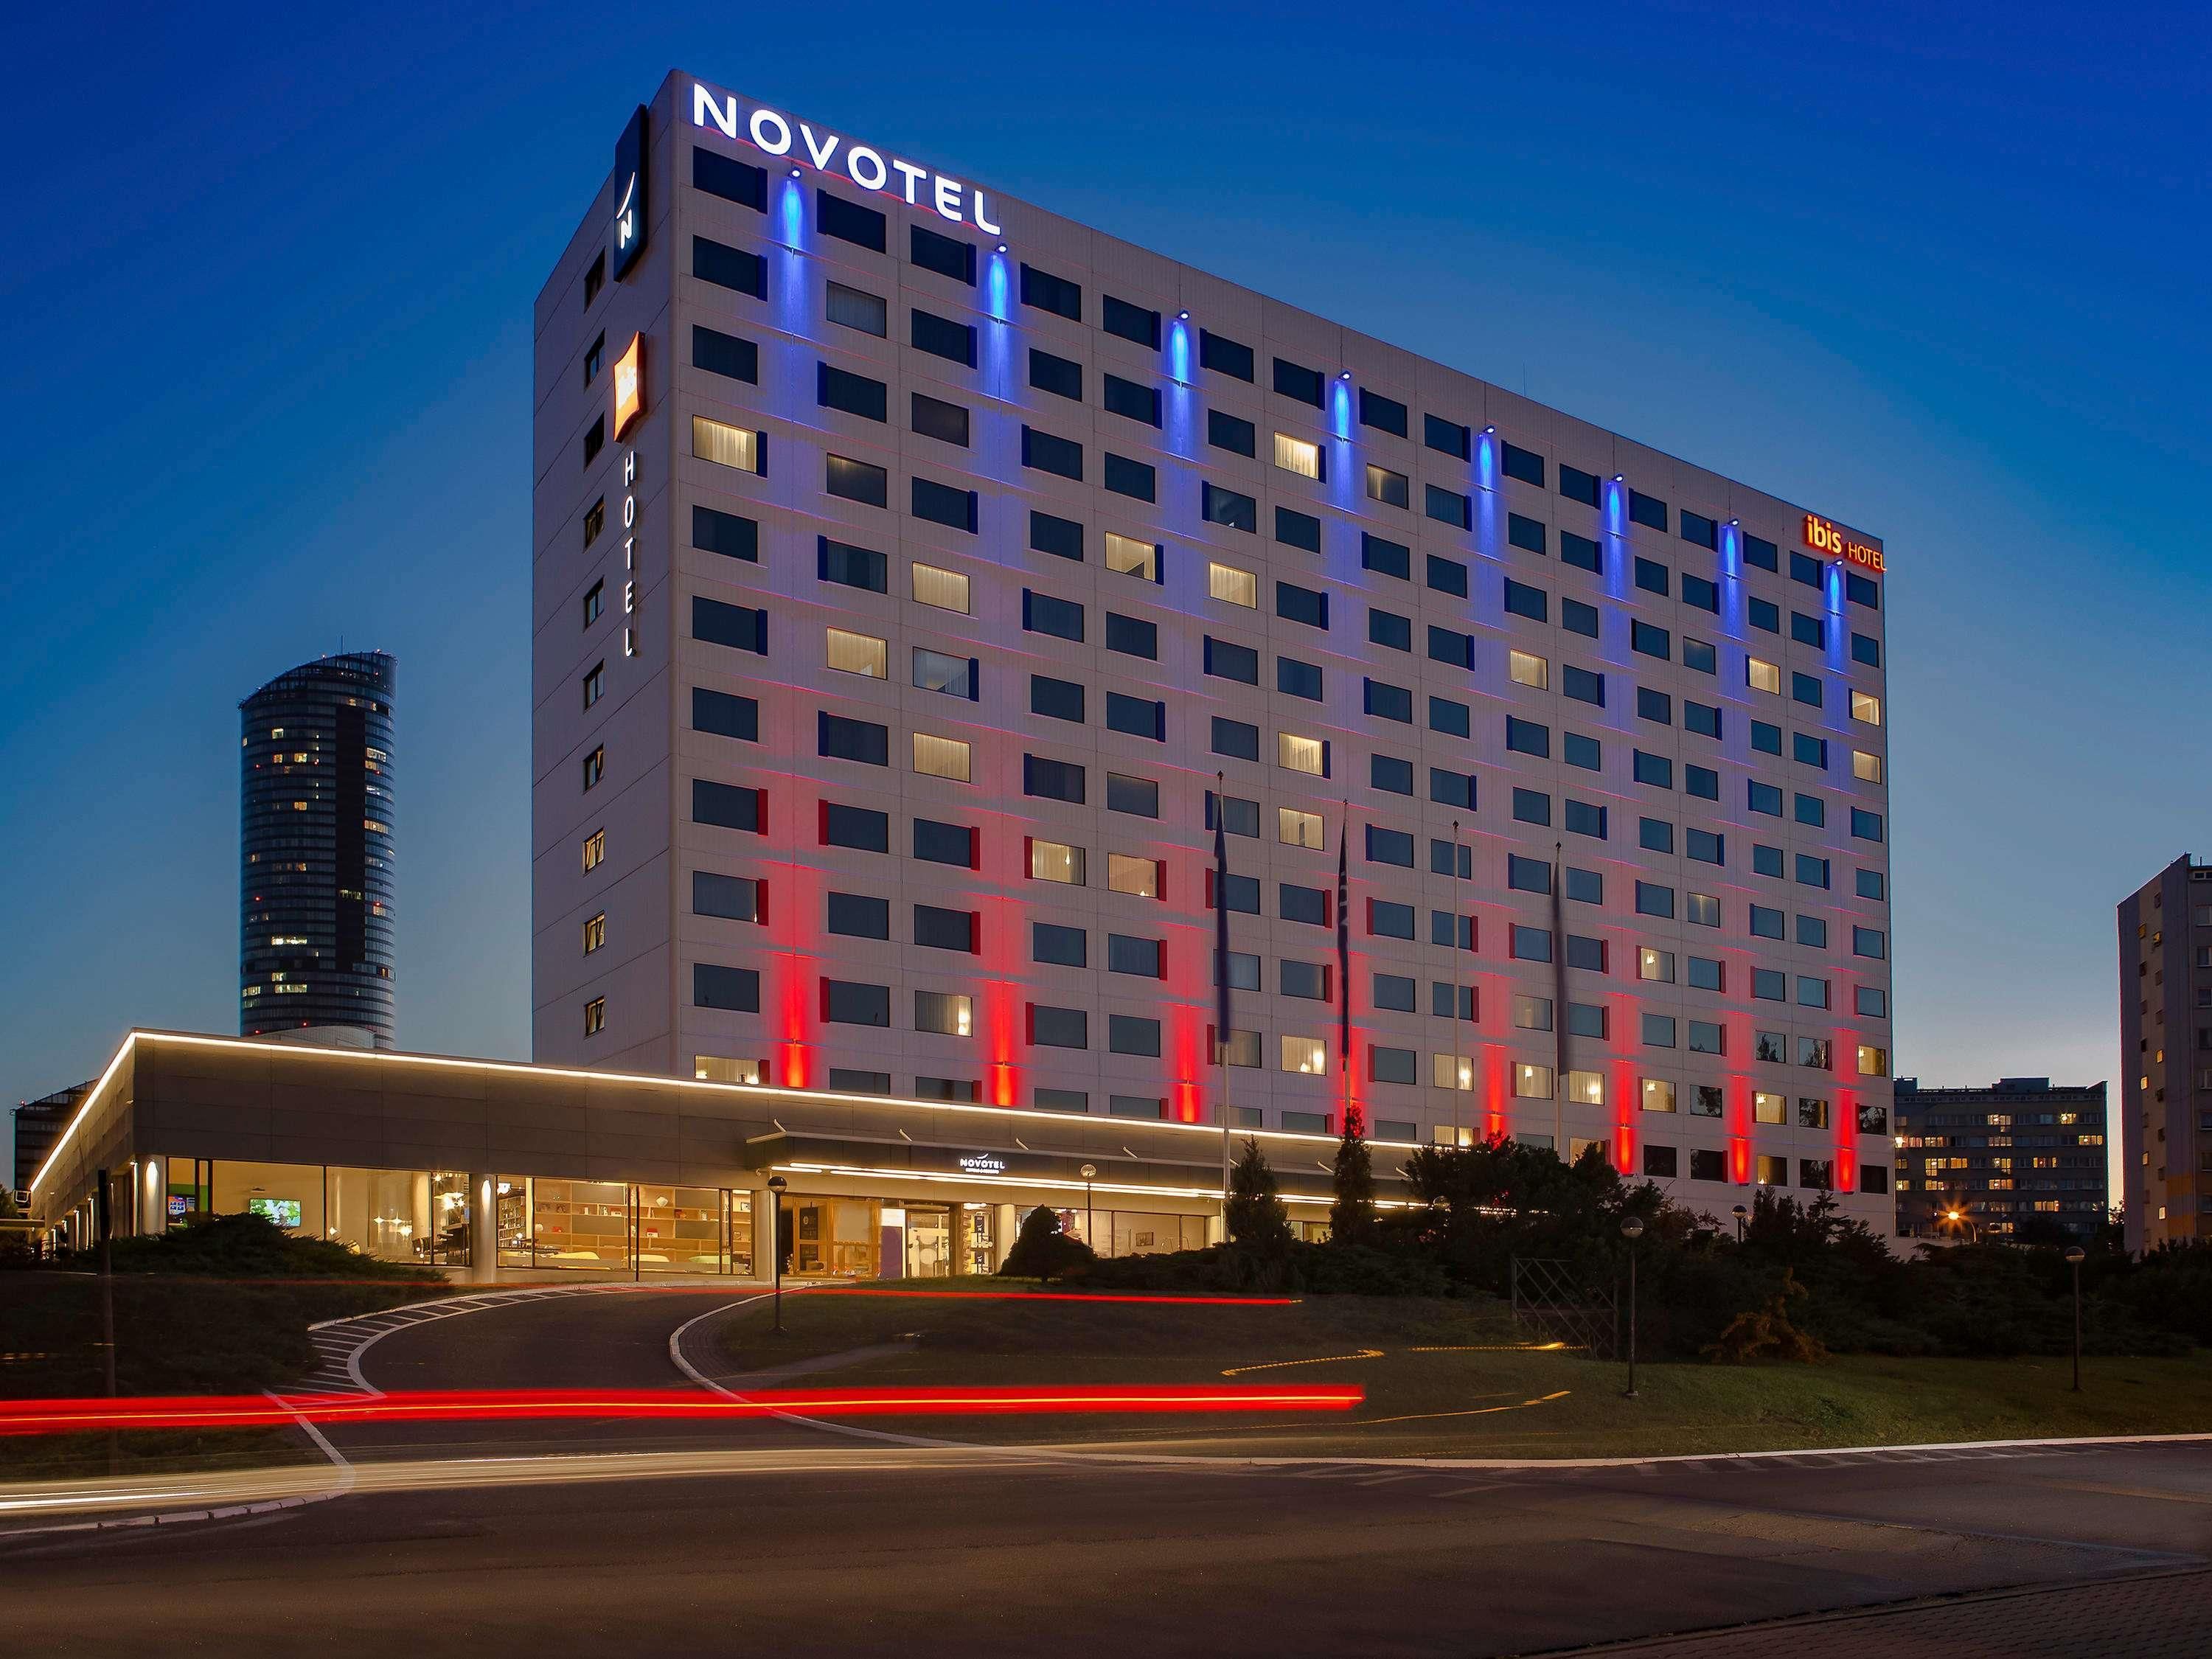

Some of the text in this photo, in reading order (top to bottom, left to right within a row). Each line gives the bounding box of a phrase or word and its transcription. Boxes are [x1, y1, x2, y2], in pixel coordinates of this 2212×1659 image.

[693, 83, 1002, 236] NOVOTEL
[624, 450, 636, 658] HOTEL
[1806, 514, 1888, 573] ibis HOTEL
[959, 1158, 1006, 1170] NOVOTEL
